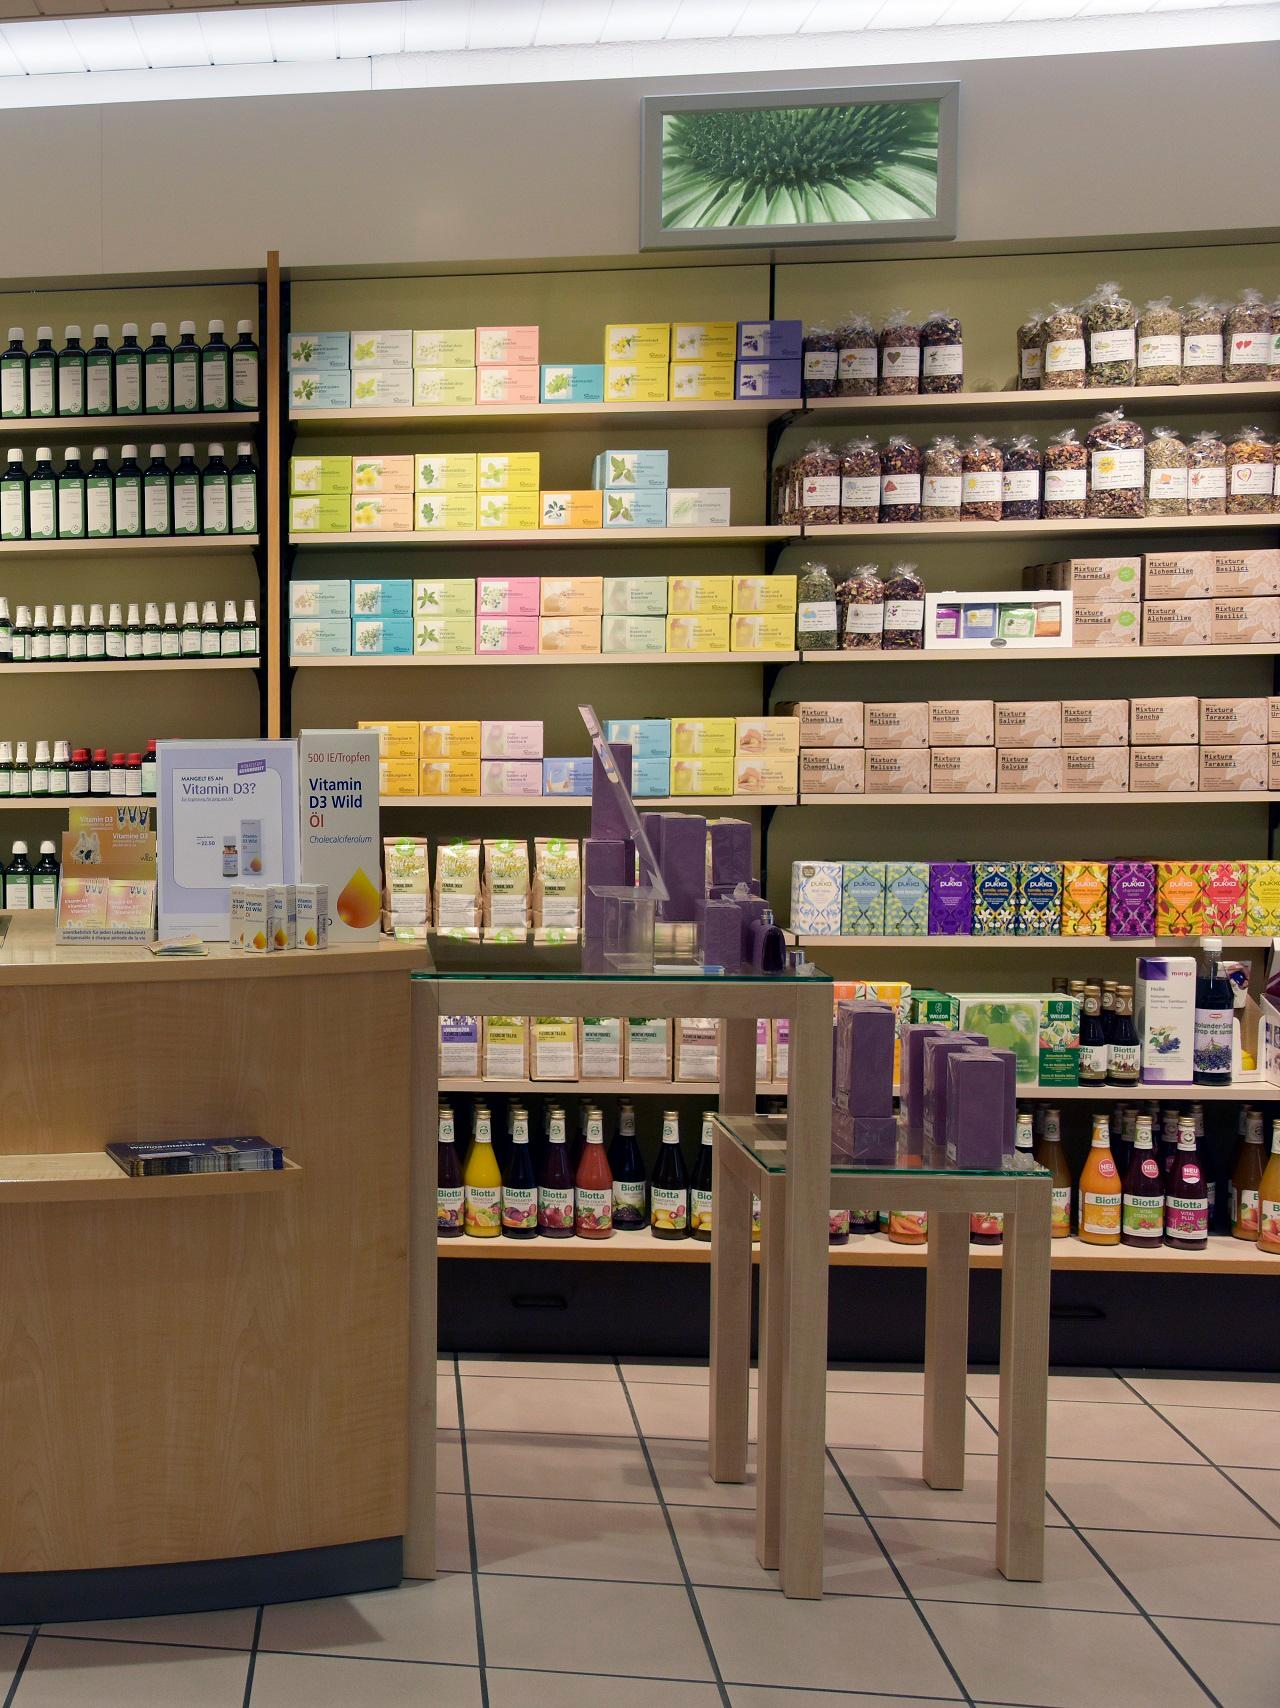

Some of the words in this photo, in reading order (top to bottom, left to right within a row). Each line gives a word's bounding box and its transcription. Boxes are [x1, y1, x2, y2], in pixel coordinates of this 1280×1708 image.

[307, 753, 324, 762] 500
[327, 753, 370, 764] IE/Tropfen
[183, 783, 229, 795] Vitamin
[234, 783, 256, 794] D3?
[309, 778, 362, 791] Vitamin
[309, 796, 327, 808] D3
[332, 795, 362, 808] Wild
[309, 812, 324, 828] Öl
[309, 835, 372, 844] Cholecalciferolum
[471, 1189, 496, 1197] Biotta
[505, 1189, 531, 1198] Biotta
[542, 1190, 568, 1199] Biotta
[579, 1191, 605, 1199] Biotta
[654, 1190, 679, 1199] Biotta
[1132, 1198, 1160, 1207] Biotta
[1173, 1200, 1202, 1209] Biotta
